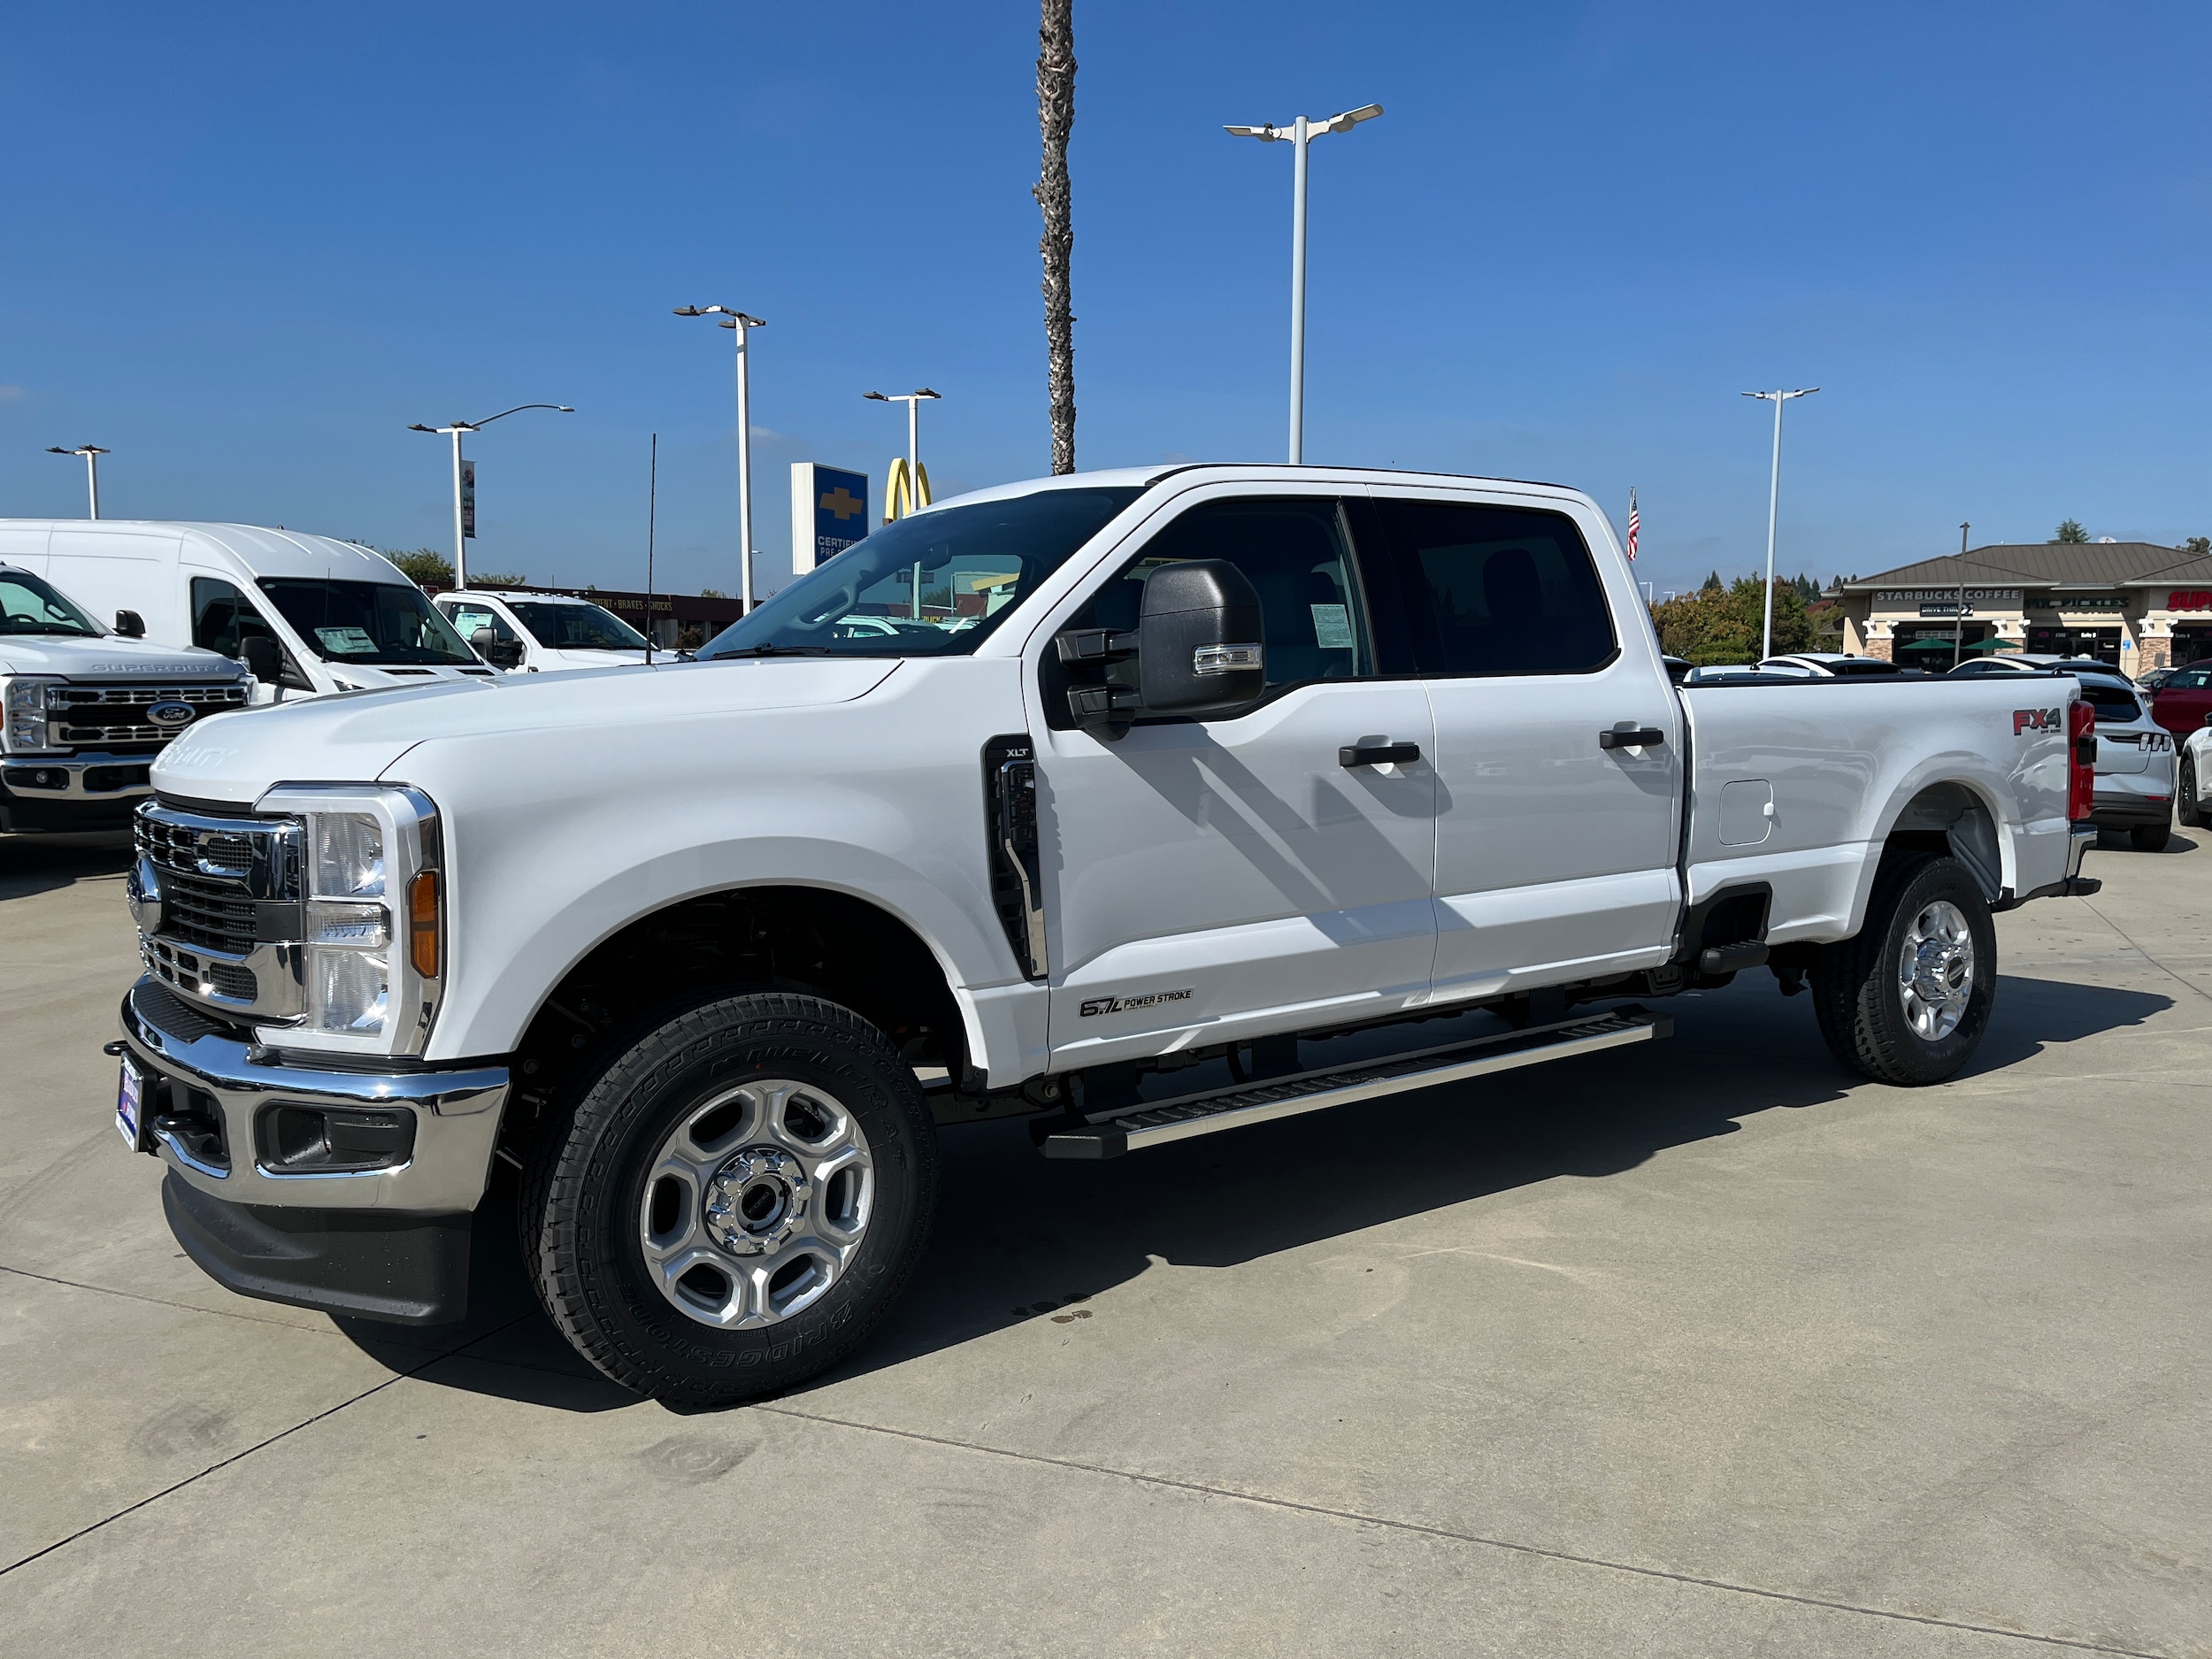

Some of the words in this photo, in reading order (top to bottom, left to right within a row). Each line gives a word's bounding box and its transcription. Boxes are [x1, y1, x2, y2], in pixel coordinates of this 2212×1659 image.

[1877, 590, 1960, 601] STARBUCKS
[1965, 590, 2019, 600] COFFEE
[2167, 590, 2212, 611] SUP
[618, 599, 643, 611] BRAKES
[649, 601, 672, 611] SHOCKS
[91, 664, 169, 672] SUPER
[163, 708, 185, 719] Ford
[2013, 708, 2062, 735] FX4
[1005, 748, 1029, 757] XLT
[1079, 996, 1122, 1017] 6.7L
[1124, 996, 1156, 1009] POWER
[1156, 990, 1192, 1002] STROKE
[616, 1281, 856, 1370] BRIDGESTONE
